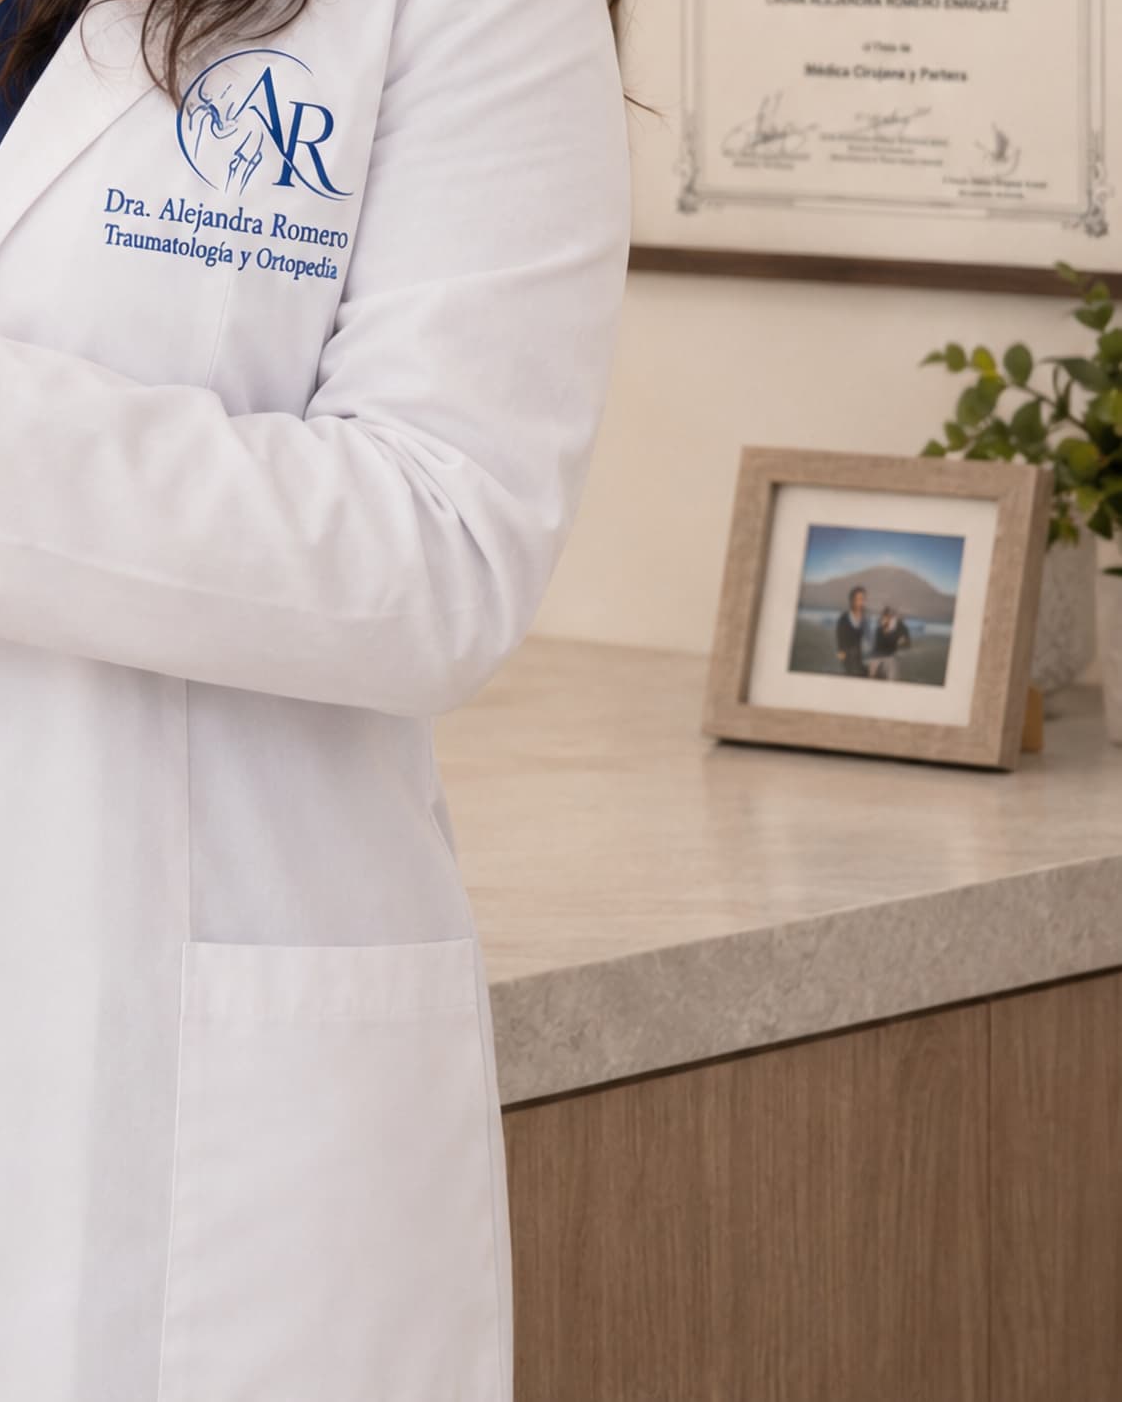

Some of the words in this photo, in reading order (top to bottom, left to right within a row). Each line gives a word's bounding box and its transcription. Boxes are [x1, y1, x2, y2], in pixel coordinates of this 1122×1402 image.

[104, 188, 150, 217] Dra.
[158, 197, 263, 234] Alejandra
[270, 213, 349, 248] Romero
[104, 223, 233, 267] Traumatología
[237, 249, 252, 271] y
[256, 248, 338, 280] Ortopedia
